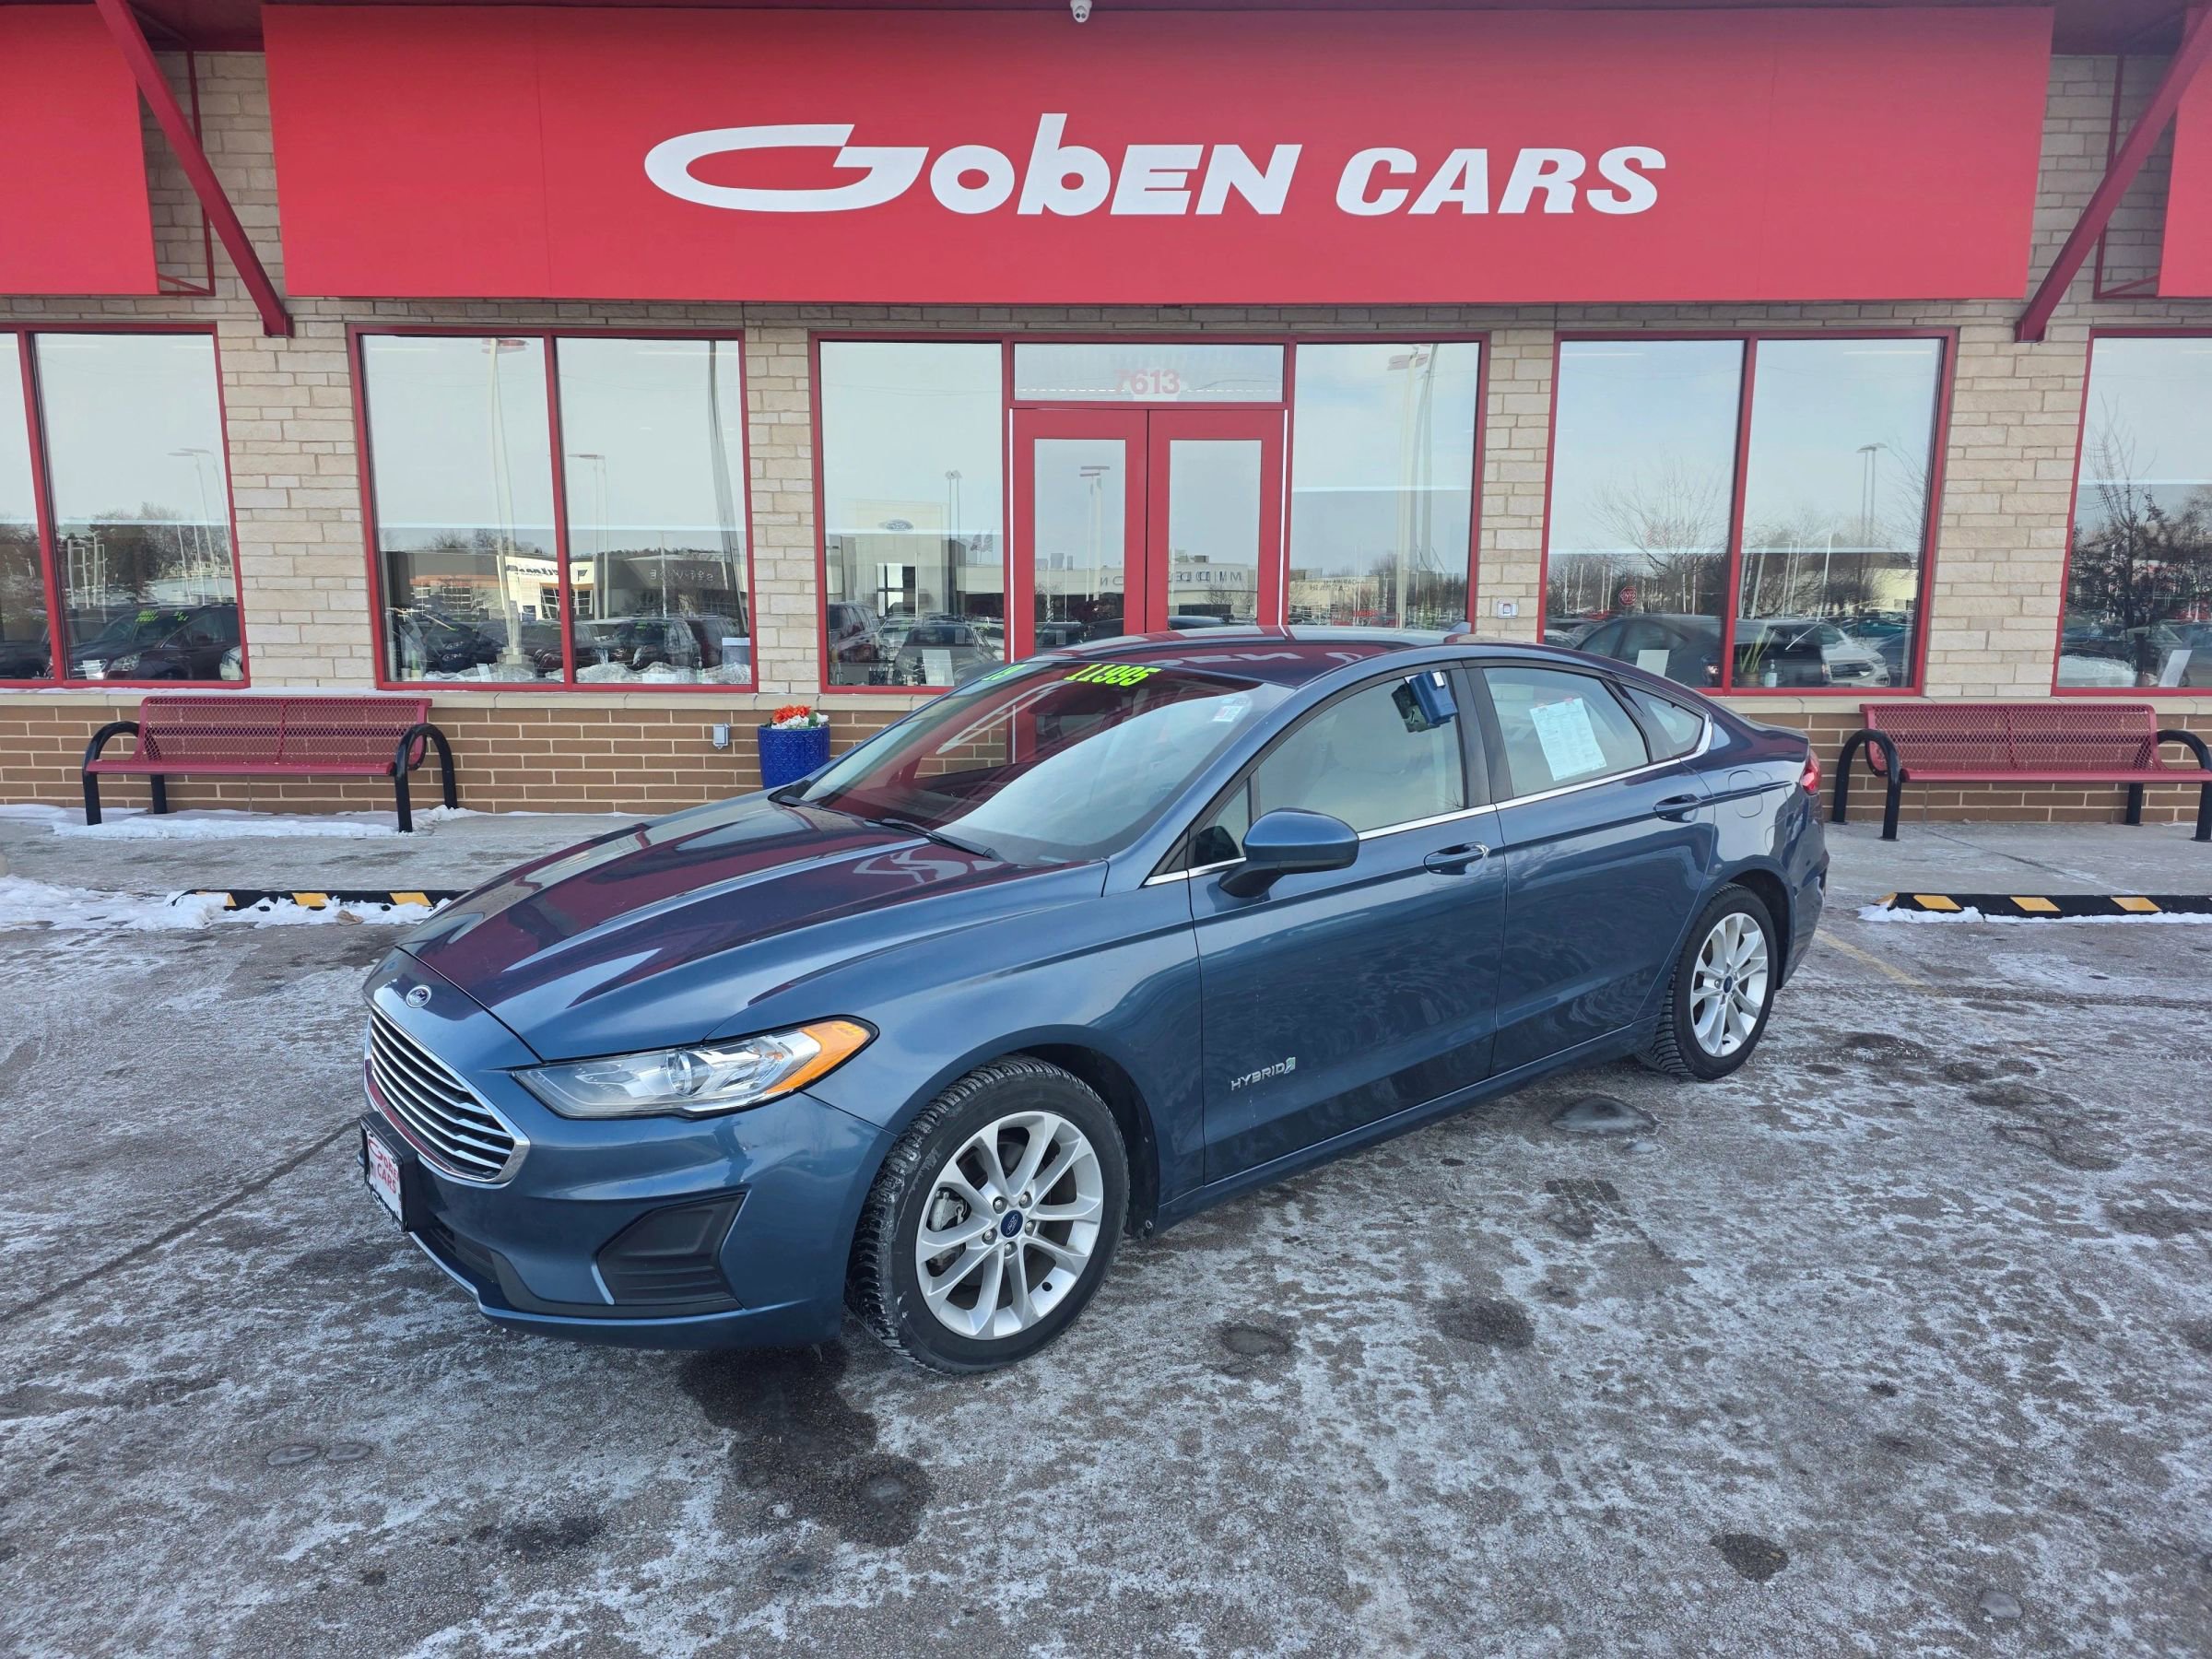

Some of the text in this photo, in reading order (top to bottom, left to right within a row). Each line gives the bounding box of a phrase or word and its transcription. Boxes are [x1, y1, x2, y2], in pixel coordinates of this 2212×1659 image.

[1335, 146, 1667, 218] CARS
[1114, 368, 1180, 395] 7613
[1063, 663, 1162, 687] 11995
[1230, 1062, 1286, 1091] HYBRID
[377, 1163, 396, 1194] CARS
